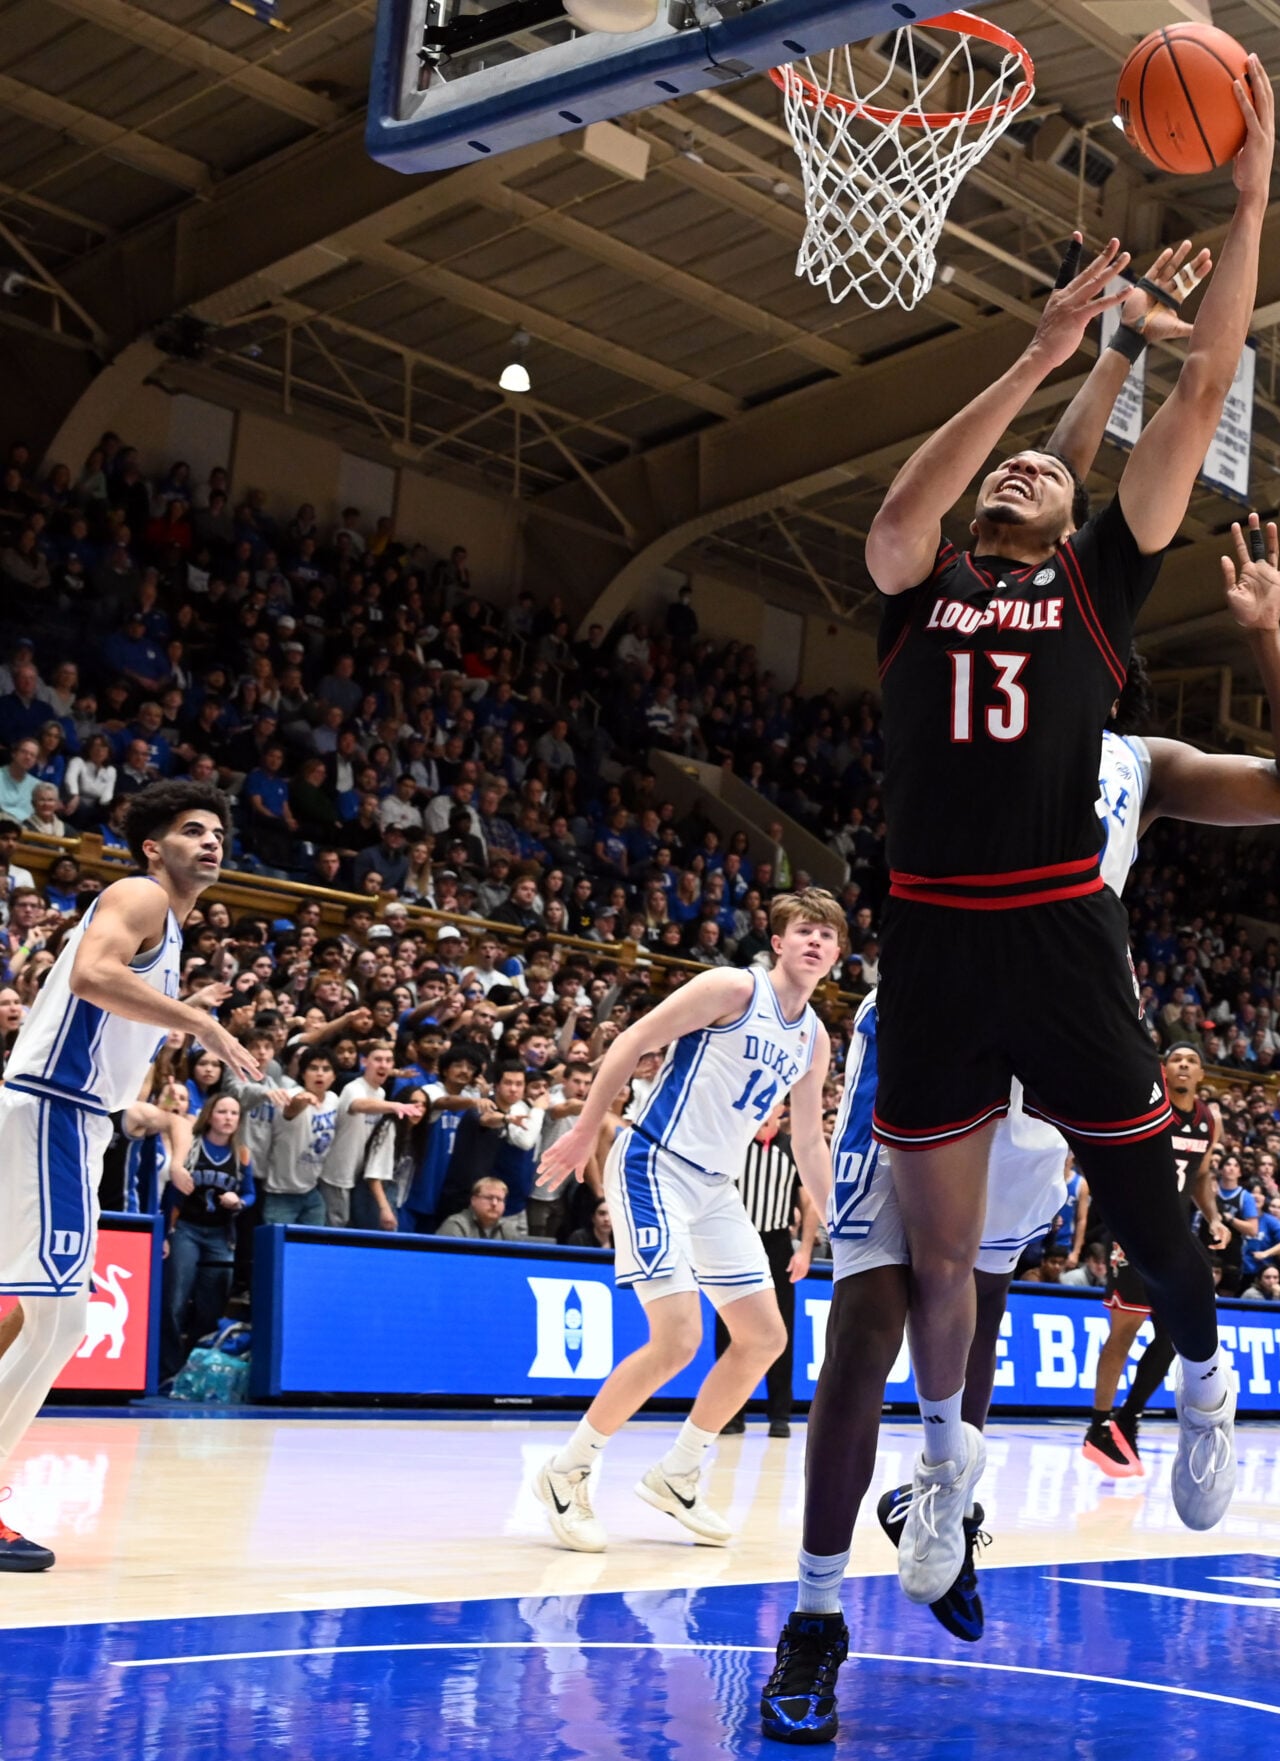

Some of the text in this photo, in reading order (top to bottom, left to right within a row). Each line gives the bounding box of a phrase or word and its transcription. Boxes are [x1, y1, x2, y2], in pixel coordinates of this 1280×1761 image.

[925, 597, 1064, 635] LOUSVILLE
[947, 650, 1031, 743] 13
[742, 1034, 800, 1086] DUKE
[732, 1069, 778, 1122] 14
[51, 1229, 81, 1255] D
[637, 1227, 659, 1248] D
